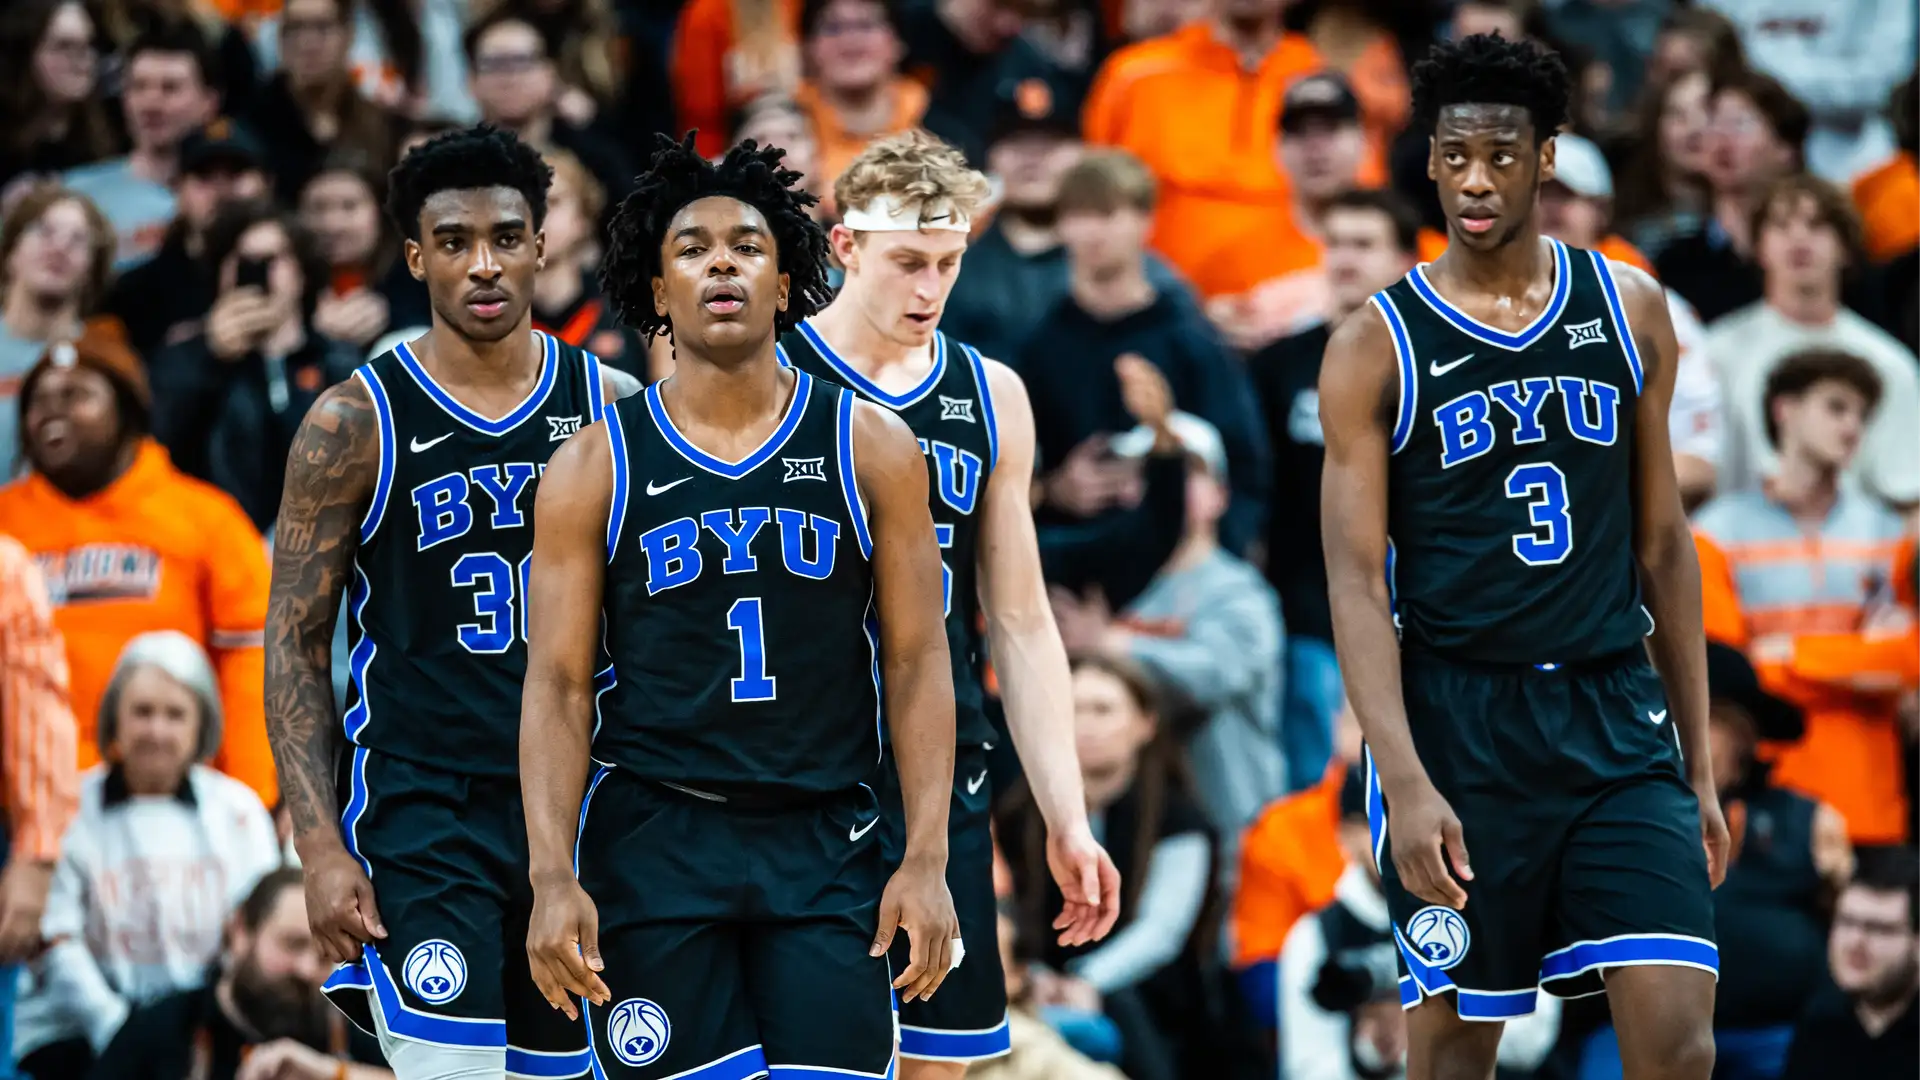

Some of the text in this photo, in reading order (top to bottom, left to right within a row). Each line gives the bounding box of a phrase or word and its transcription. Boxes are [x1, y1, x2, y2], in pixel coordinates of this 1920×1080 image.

[1433, 376, 1620, 469] BYU
[411, 463, 548, 552] BY
[783, 459, 825, 481] XII
[917, 438, 982, 515] U
[1504, 461, 1573, 566] 3
[639, 507, 840, 596] BYU
[450, 550, 533, 654] 3
[727, 597, 776, 702] 1
[425, 978, 446, 993] Y
[628, 1038, 649, 1054] Y
